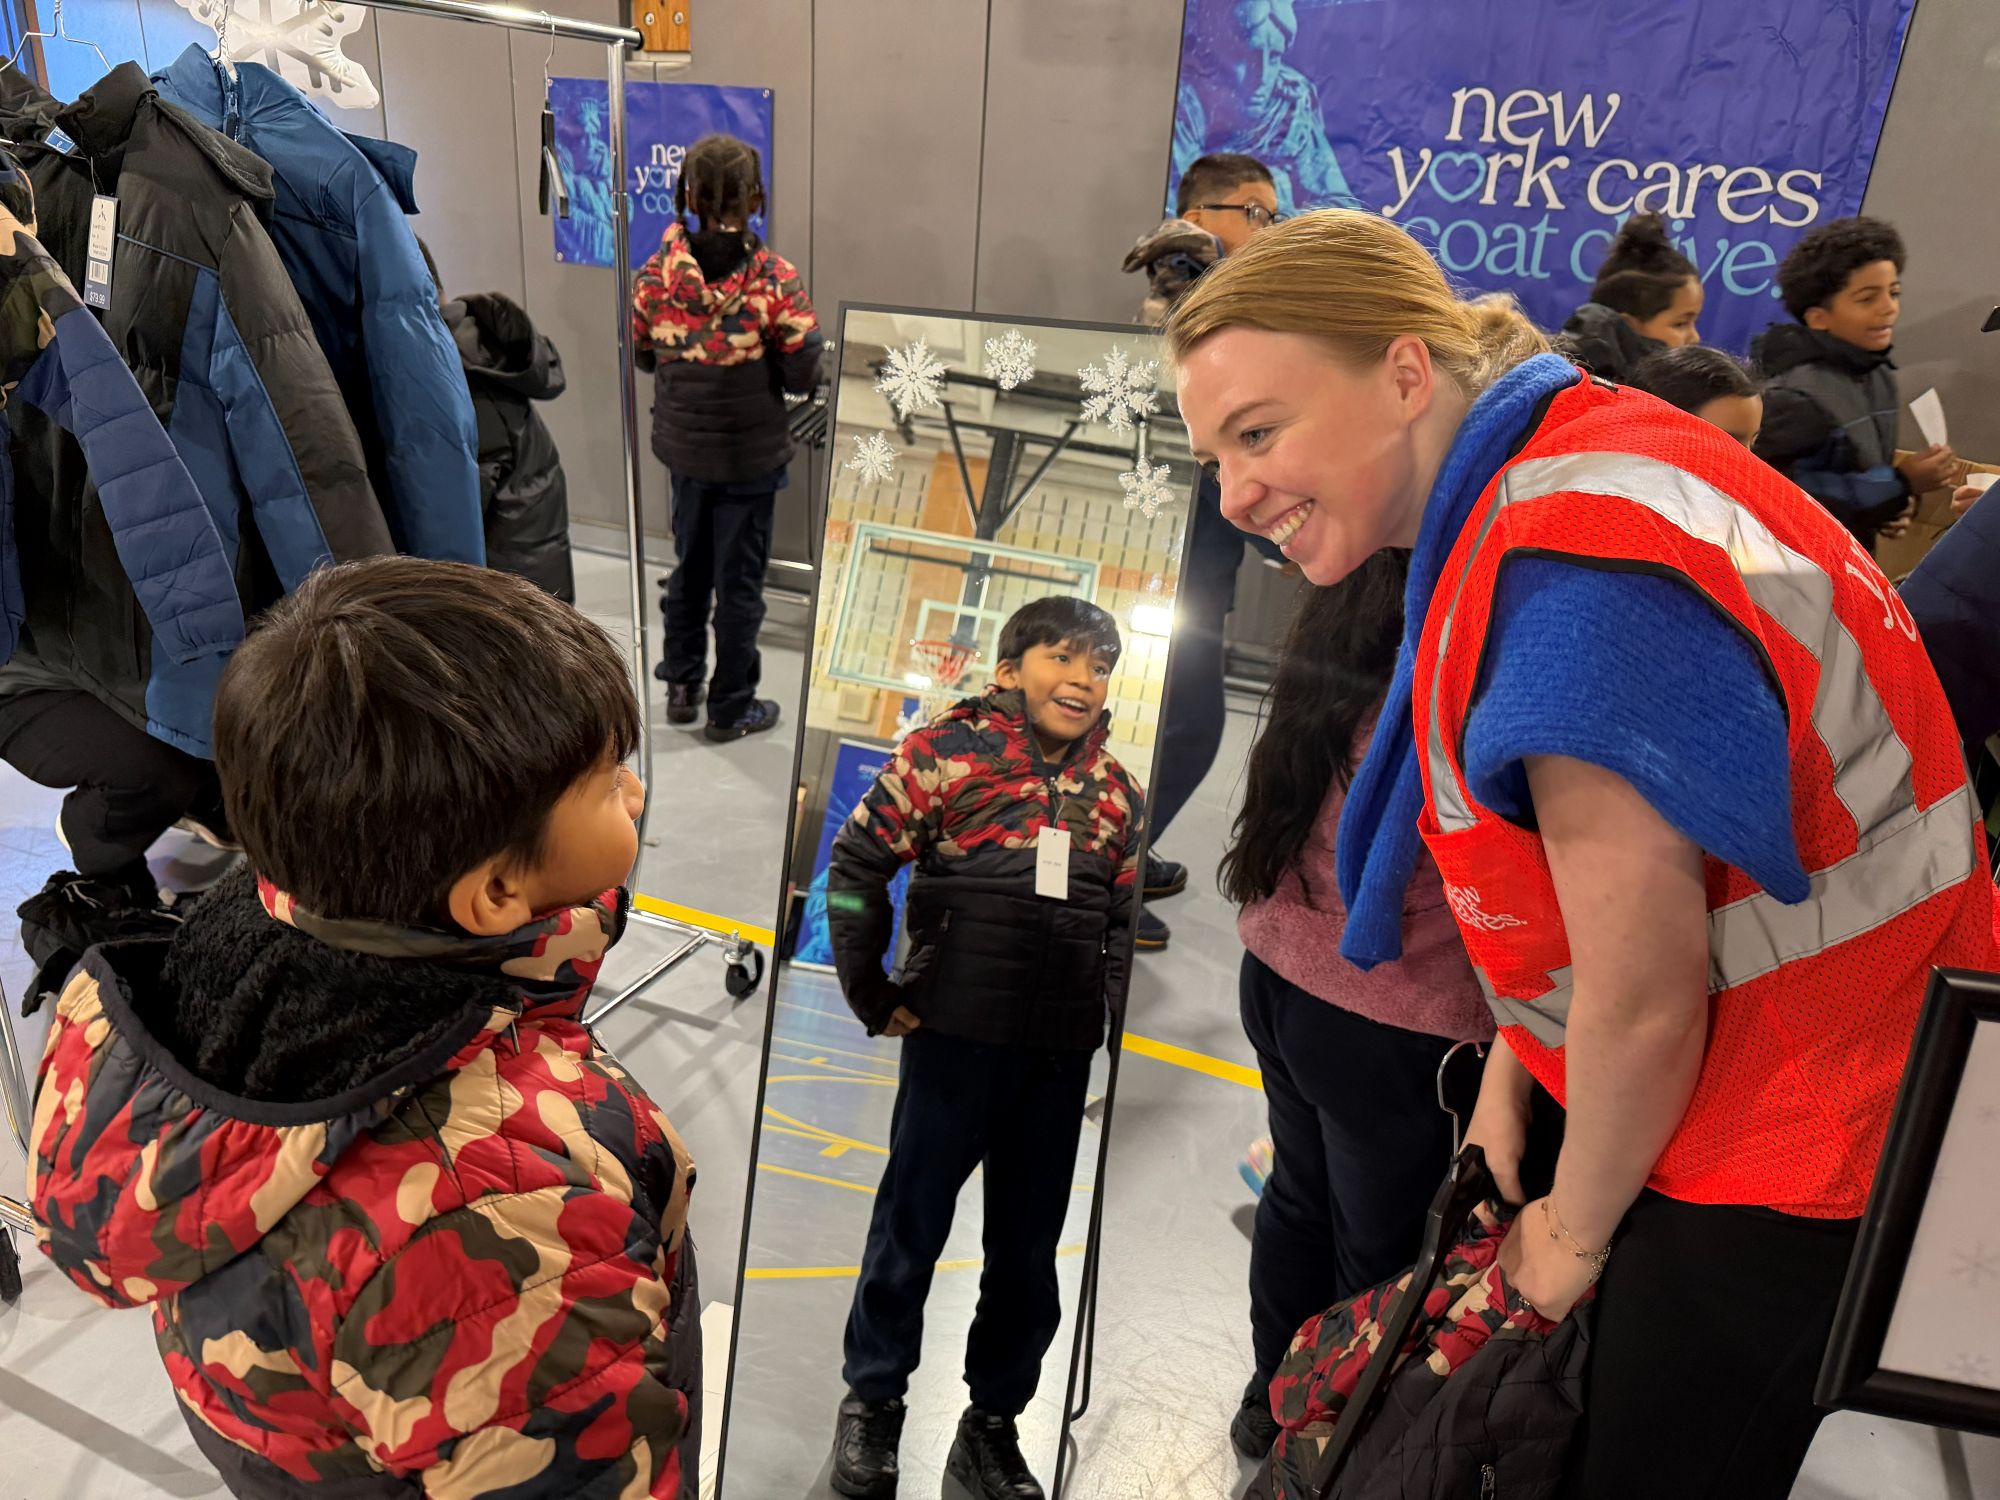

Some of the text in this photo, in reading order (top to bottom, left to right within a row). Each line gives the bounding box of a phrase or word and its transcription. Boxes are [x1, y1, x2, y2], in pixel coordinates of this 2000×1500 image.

[1445, 85, 1621, 149] new
[651, 144, 687, 166] ne
[1587, 158, 1823, 228] cares
[1570, 210, 1783, 299] dve.
